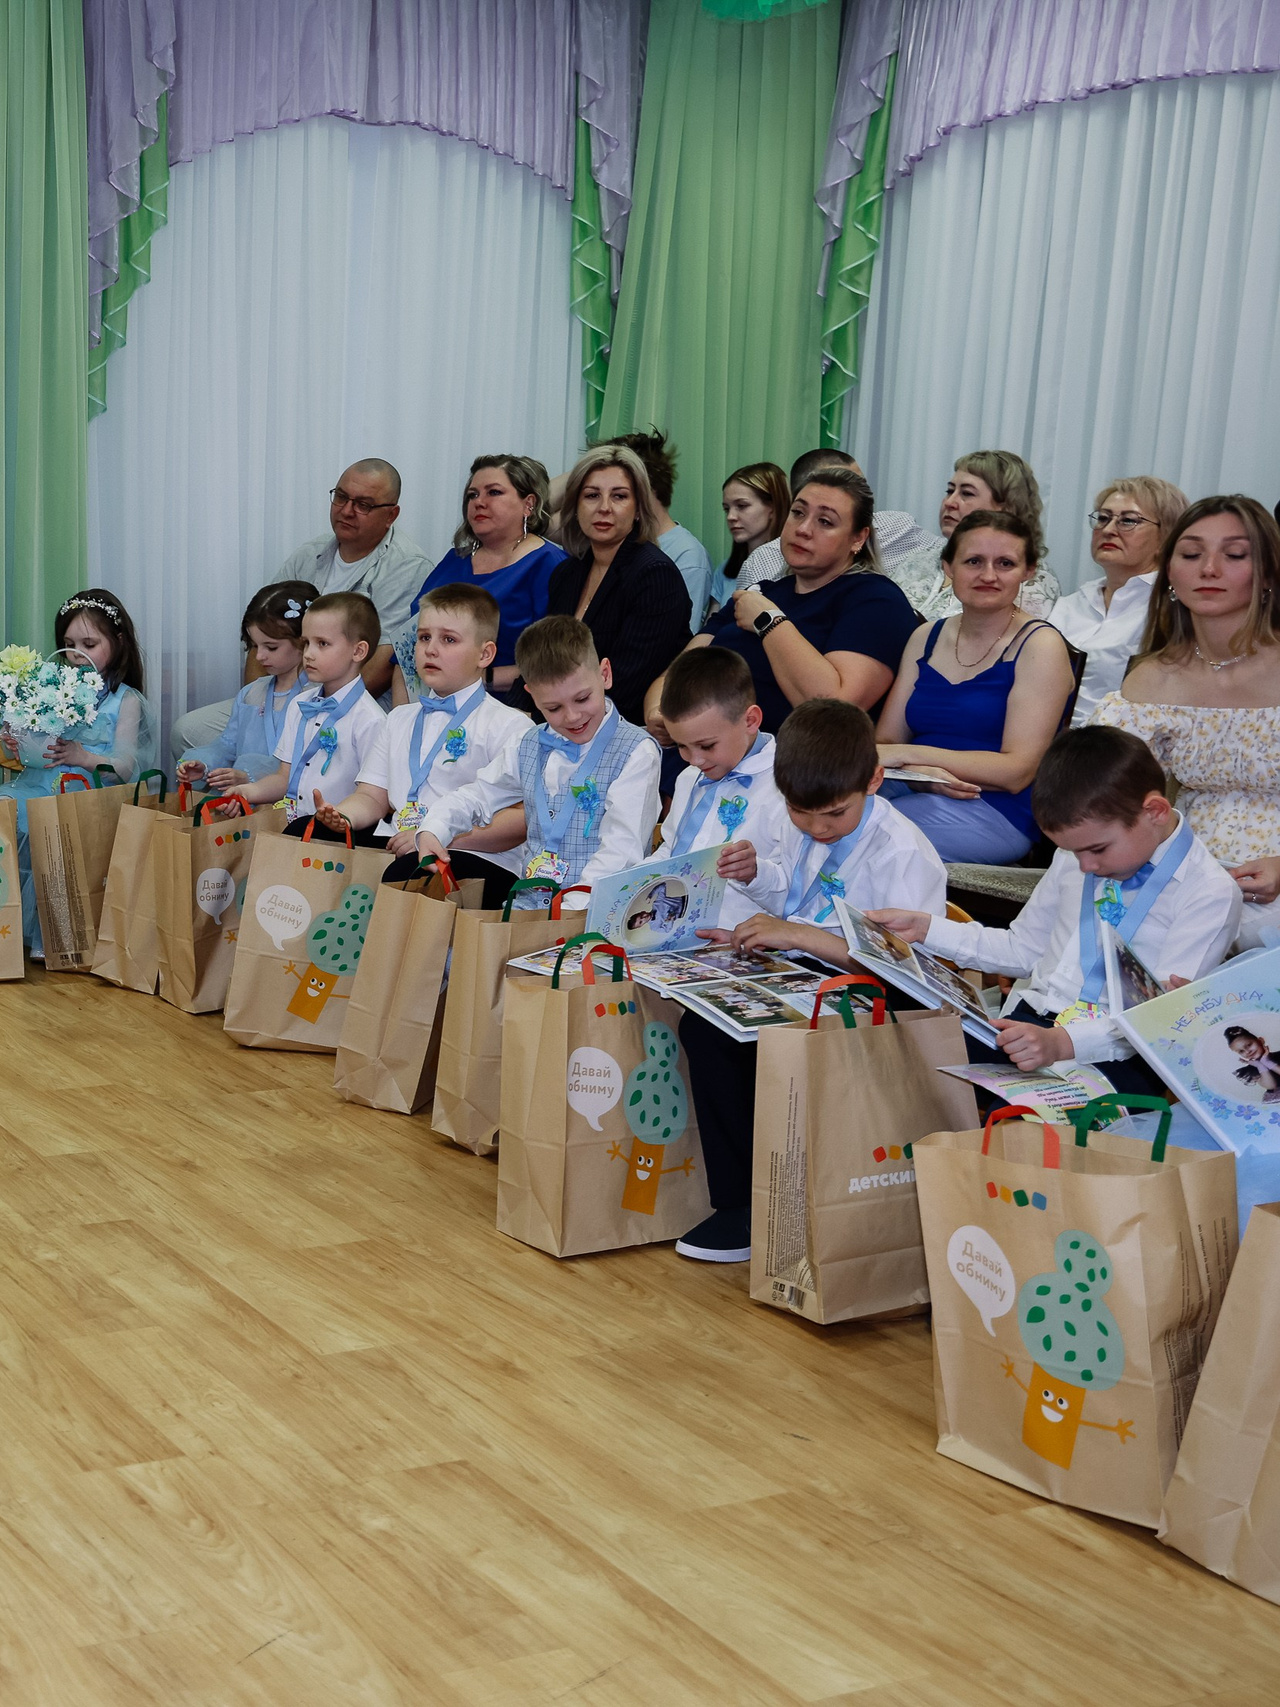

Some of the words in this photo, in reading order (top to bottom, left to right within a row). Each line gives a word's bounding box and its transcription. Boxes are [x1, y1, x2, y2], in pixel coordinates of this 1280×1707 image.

[202, 879, 228, 891] Давай
[199, 891, 229, 902] обниму
[267, 893, 303, 915] Давай
[260, 906, 302, 930] обниму
[1170, 990, 1264, 1033] НЕЗАБУДКА
[571, 1062, 611, 1078] Давай
[568, 1079, 615, 1099] обниму
[962, 1240, 1003, 1278] Давай
[956, 1261, 1006, 1302] обниму
